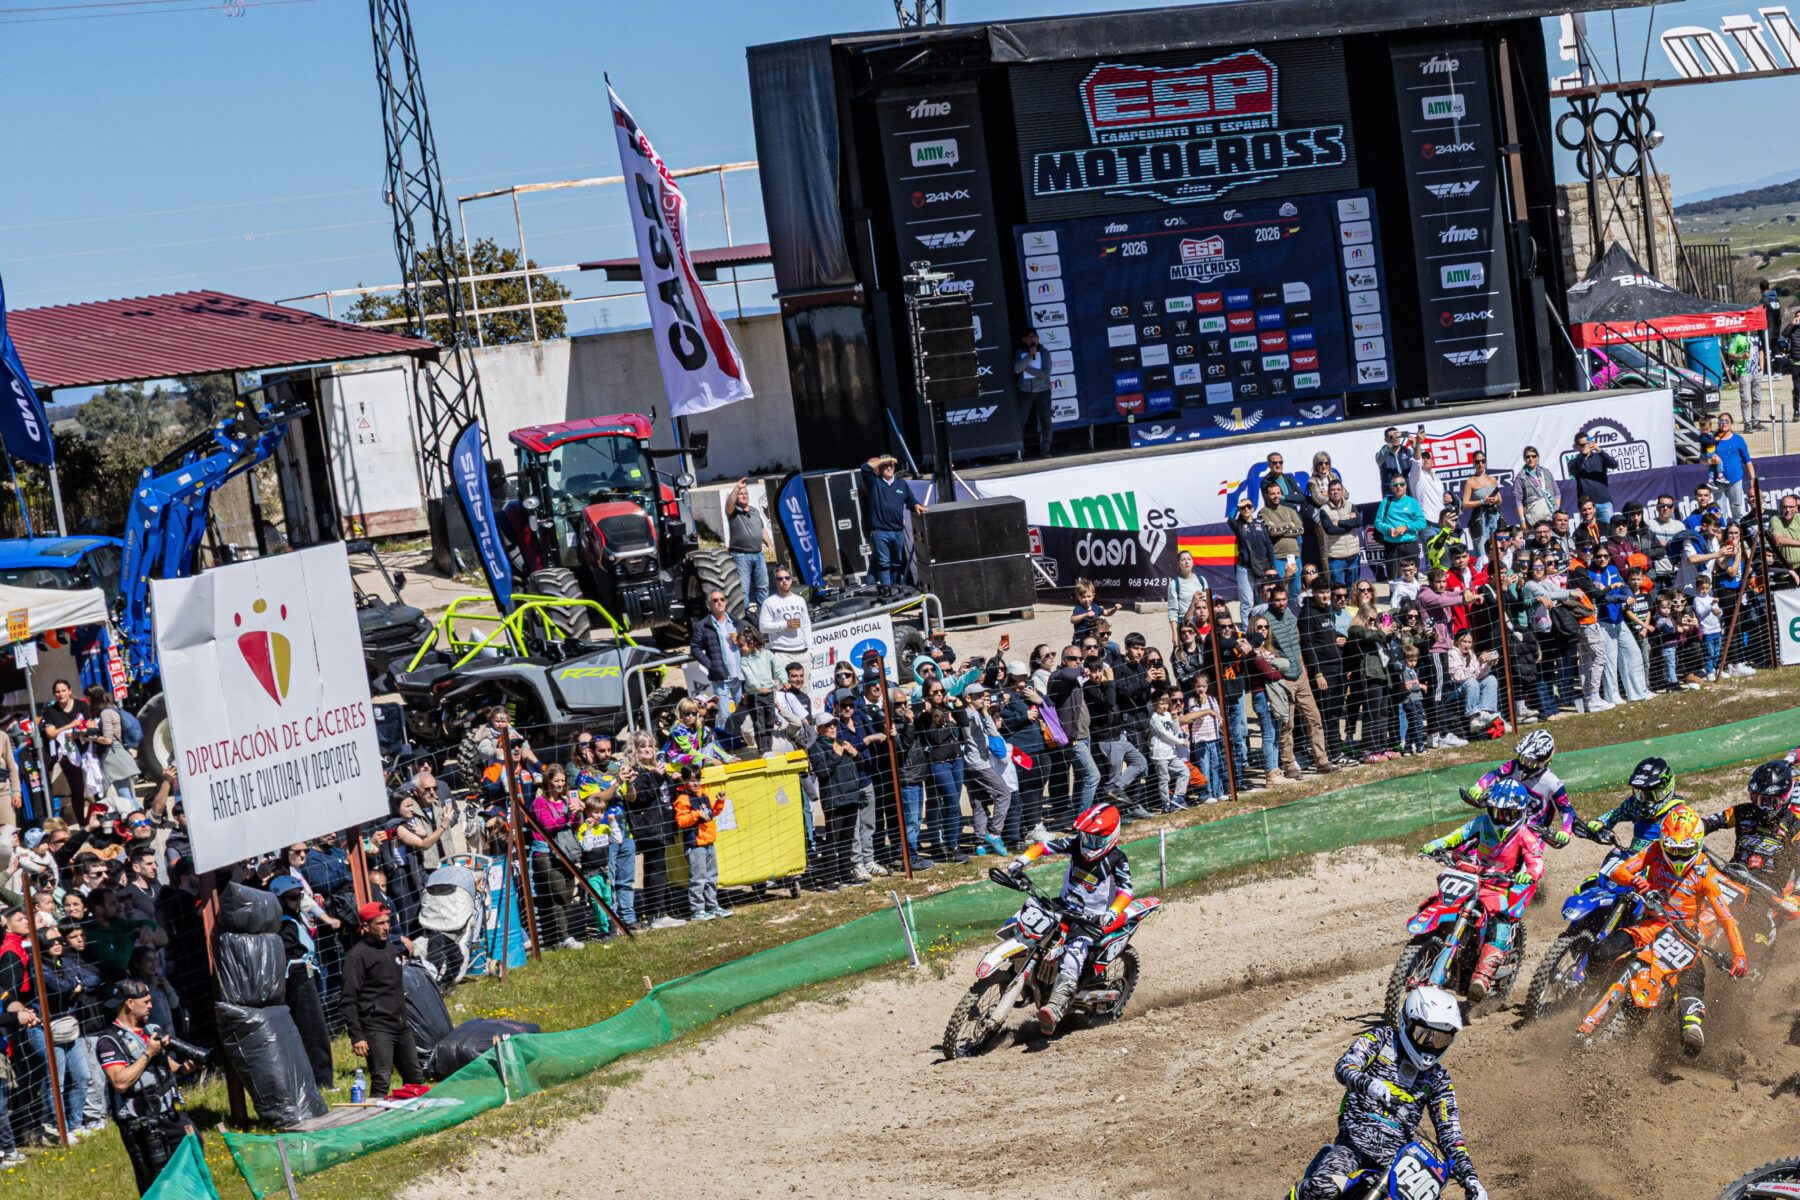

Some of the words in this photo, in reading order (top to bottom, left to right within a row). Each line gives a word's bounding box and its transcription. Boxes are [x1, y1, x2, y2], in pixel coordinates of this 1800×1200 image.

[1094, 70, 1269, 122] ESP
[1101, 126, 1190, 144] CAMPEONATO
[1196, 122, 1214, 135] DE
[1435, 142, 1476, 154] 24MX
[1036, 126, 1346, 194] MOTOCROSS
[926, 189, 970, 202] 24MX
[1255, 227, 1280, 242] 2026
[1439, 225, 1478, 243] rfme
[1121, 241, 1148, 257] 2026
[1183, 241, 1223, 257] ESP
[1171, 260, 1240, 279] MOTOCROSS
[1453, 309, 1494, 322] 24MX
[1231, 407, 1243, 430] 1
[1312, 405, 1324, 419] 3
[1614, 445, 1645, 459] CAMPO
[850, 621, 882, 636] OFICIAL
[559, 665, 621, 681] RZR
[186, 724, 280, 776] DIPUTACIÓN
[282, 722, 301, 751] DE
[304, 702, 366, 742] CÁCERES
[209, 774, 241, 821] ÁREA
[241, 773, 256, 811] DE
[256, 756, 303, 807] CULTURA
[303, 756, 313, 793] Y
[312, 741, 361, 790] DEPORTES
[1653, 932, 1694, 970] 220
